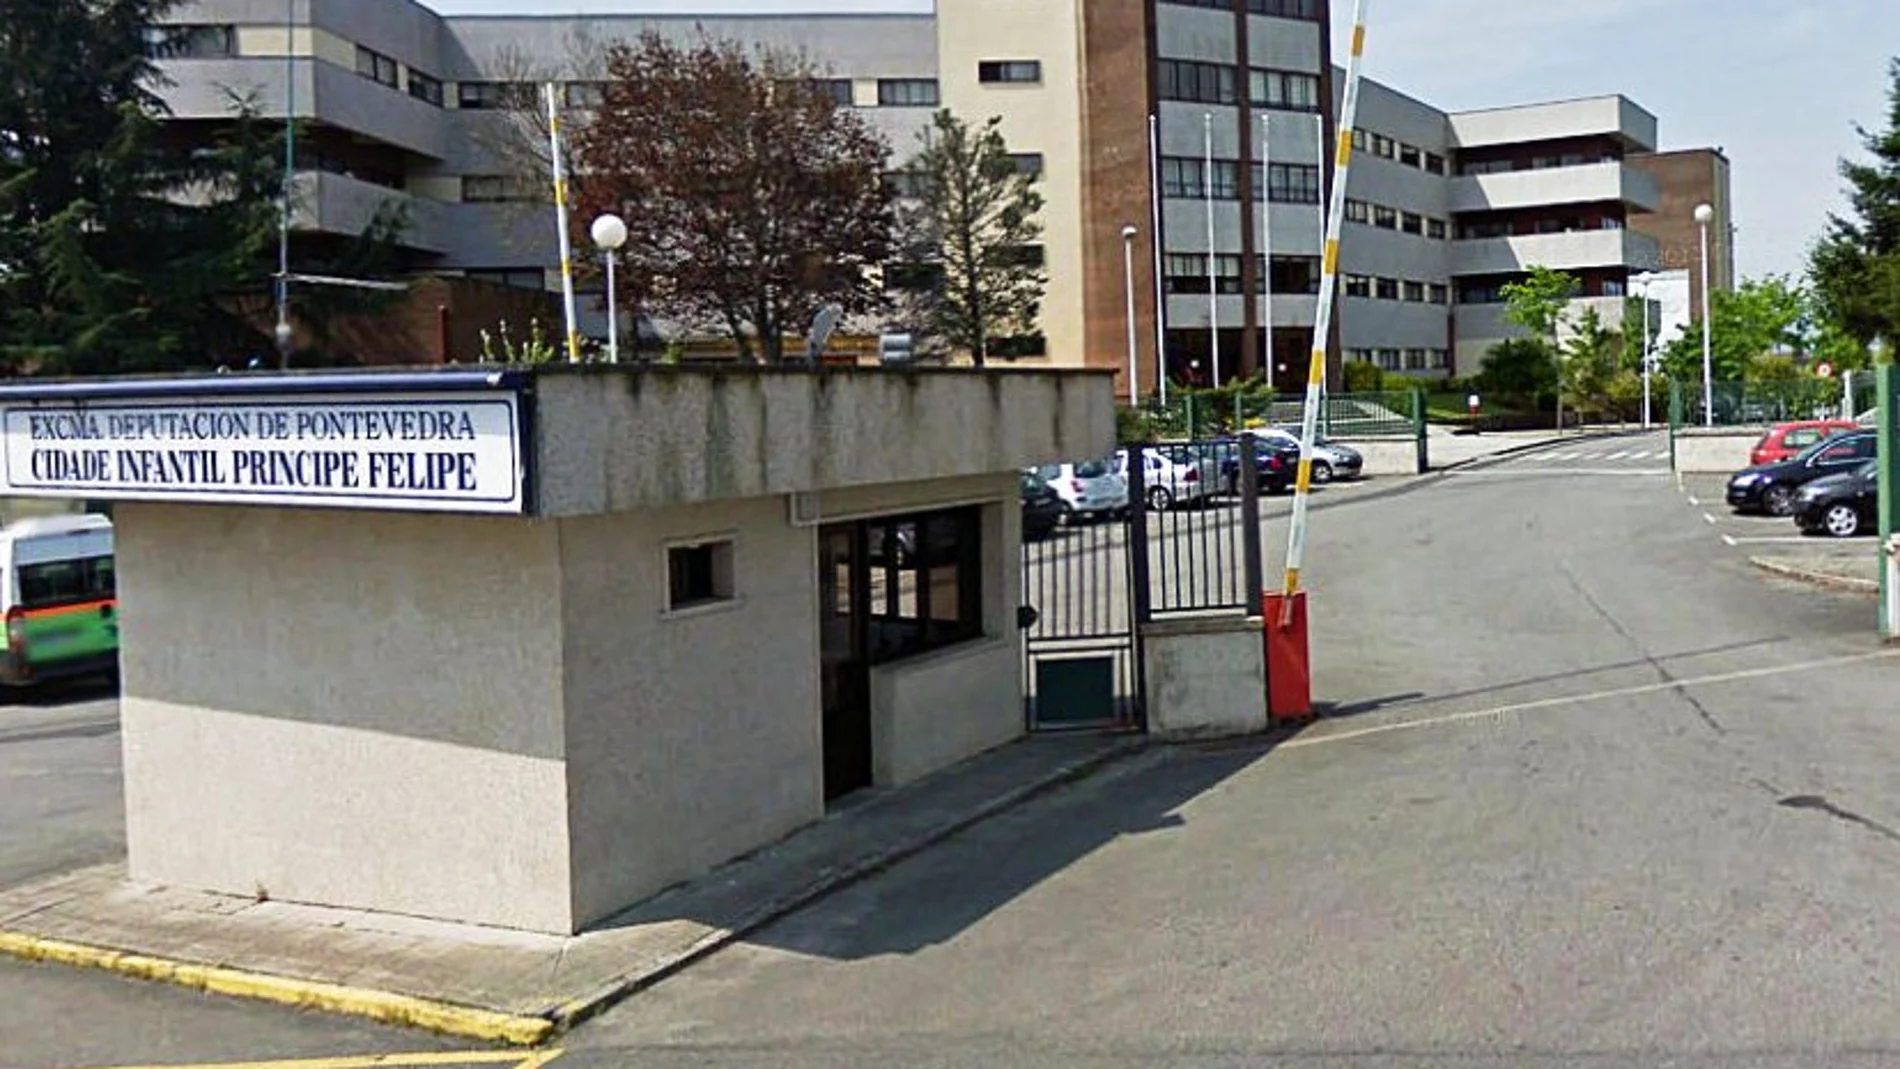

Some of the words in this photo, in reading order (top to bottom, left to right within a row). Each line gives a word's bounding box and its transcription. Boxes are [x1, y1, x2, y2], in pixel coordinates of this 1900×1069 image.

[108, 412, 249, 440] DEPUTACION
[257, 411, 290, 440] DE
[297, 410, 477, 440] PONTEVEDRA
[31, 449, 111, 481] CIDADE
[117, 449, 226, 484] INFANTIL
[232, 449, 360, 488] PRINCIPE
[367, 451, 478, 491] FELIPE
